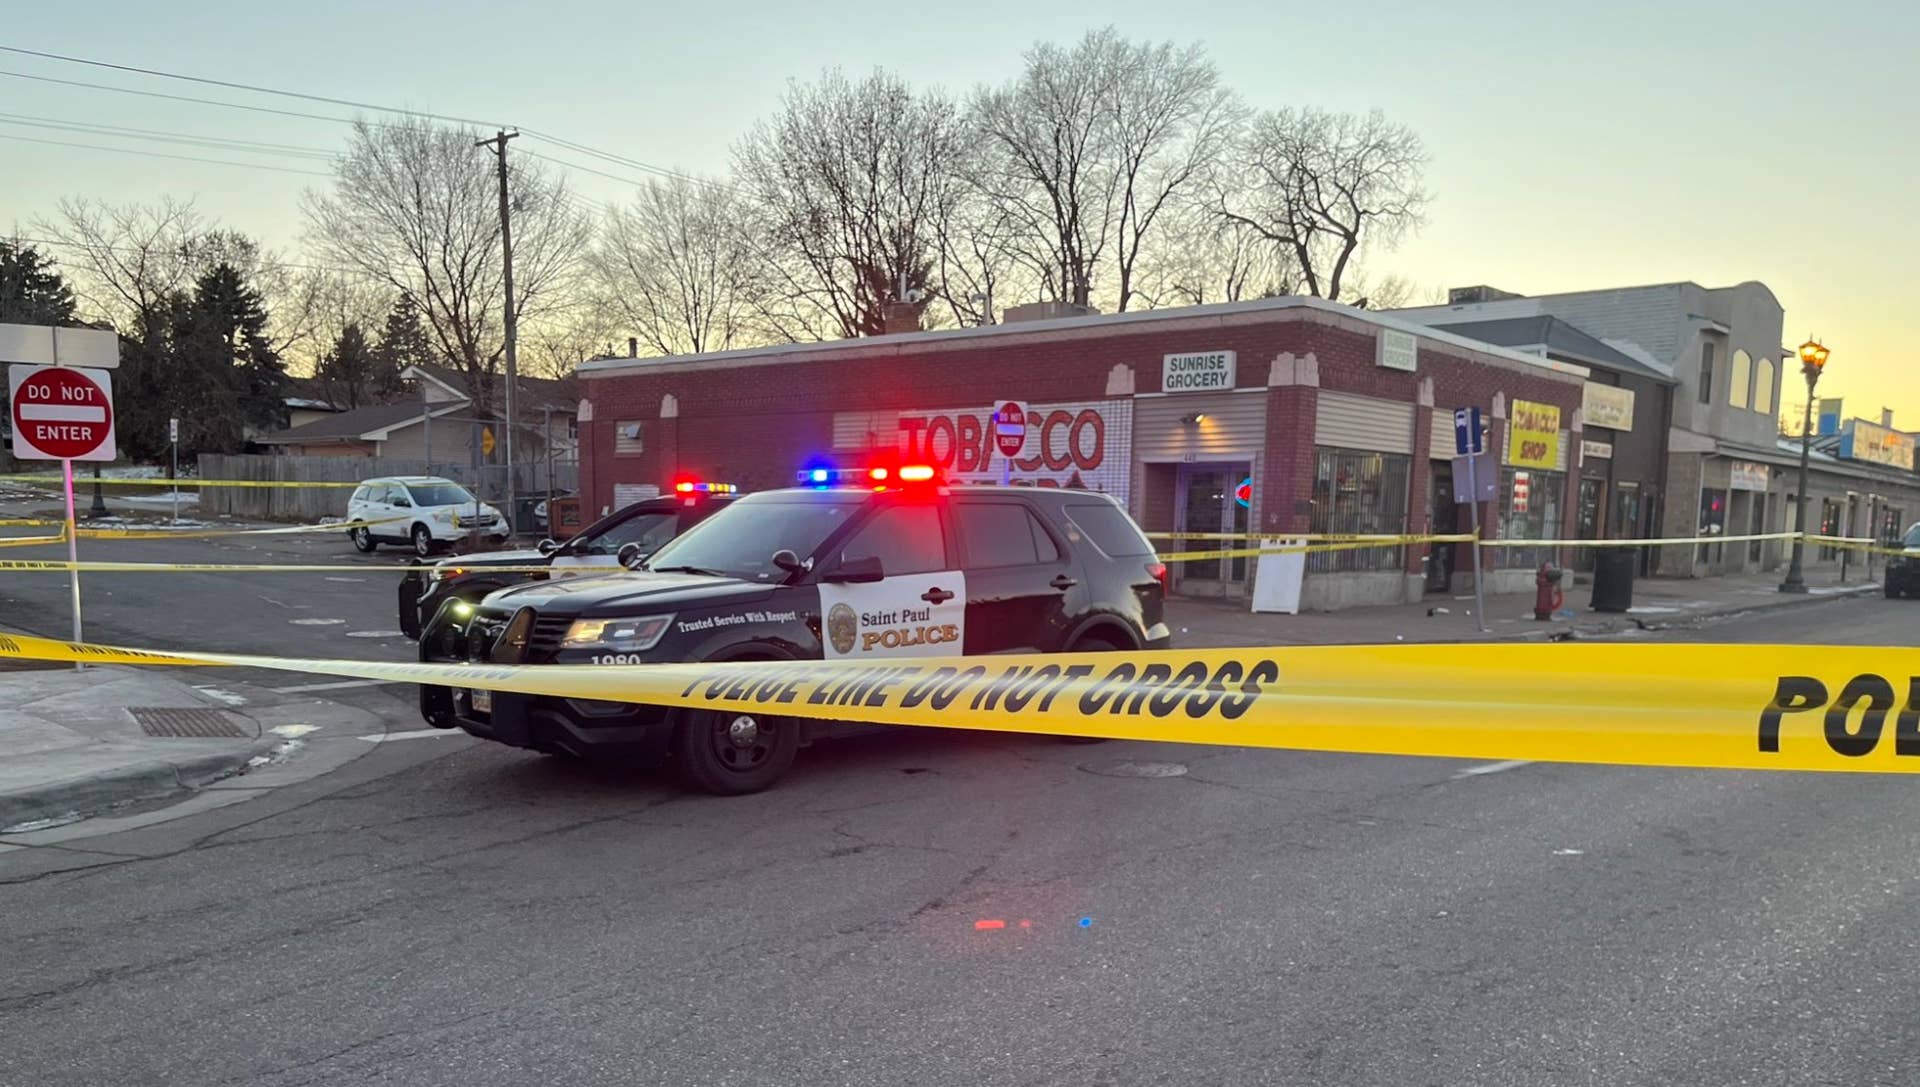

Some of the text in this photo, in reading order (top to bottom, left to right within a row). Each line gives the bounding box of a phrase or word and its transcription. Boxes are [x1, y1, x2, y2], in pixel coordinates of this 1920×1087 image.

[1170, 355, 1225, 372] SUNRISE
[1166, 371, 1228, 388] GROCERY
[28, 384, 94, 401] DO NOT
[999, 412, 1022, 422] DO NOT
[36, 425, 92, 440] ENTER
[1001, 437, 1020, 447] ENTER
[1520, 440, 1547, 461] SHOP
[678, 610, 797, 633] Trusted Service With Respect
[861, 607, 931, 627] Saint Paul
[861, 623, 959, 652] POLICE
[681, 659, 1279, 719] POLICE LINE DO NOT CROSS
